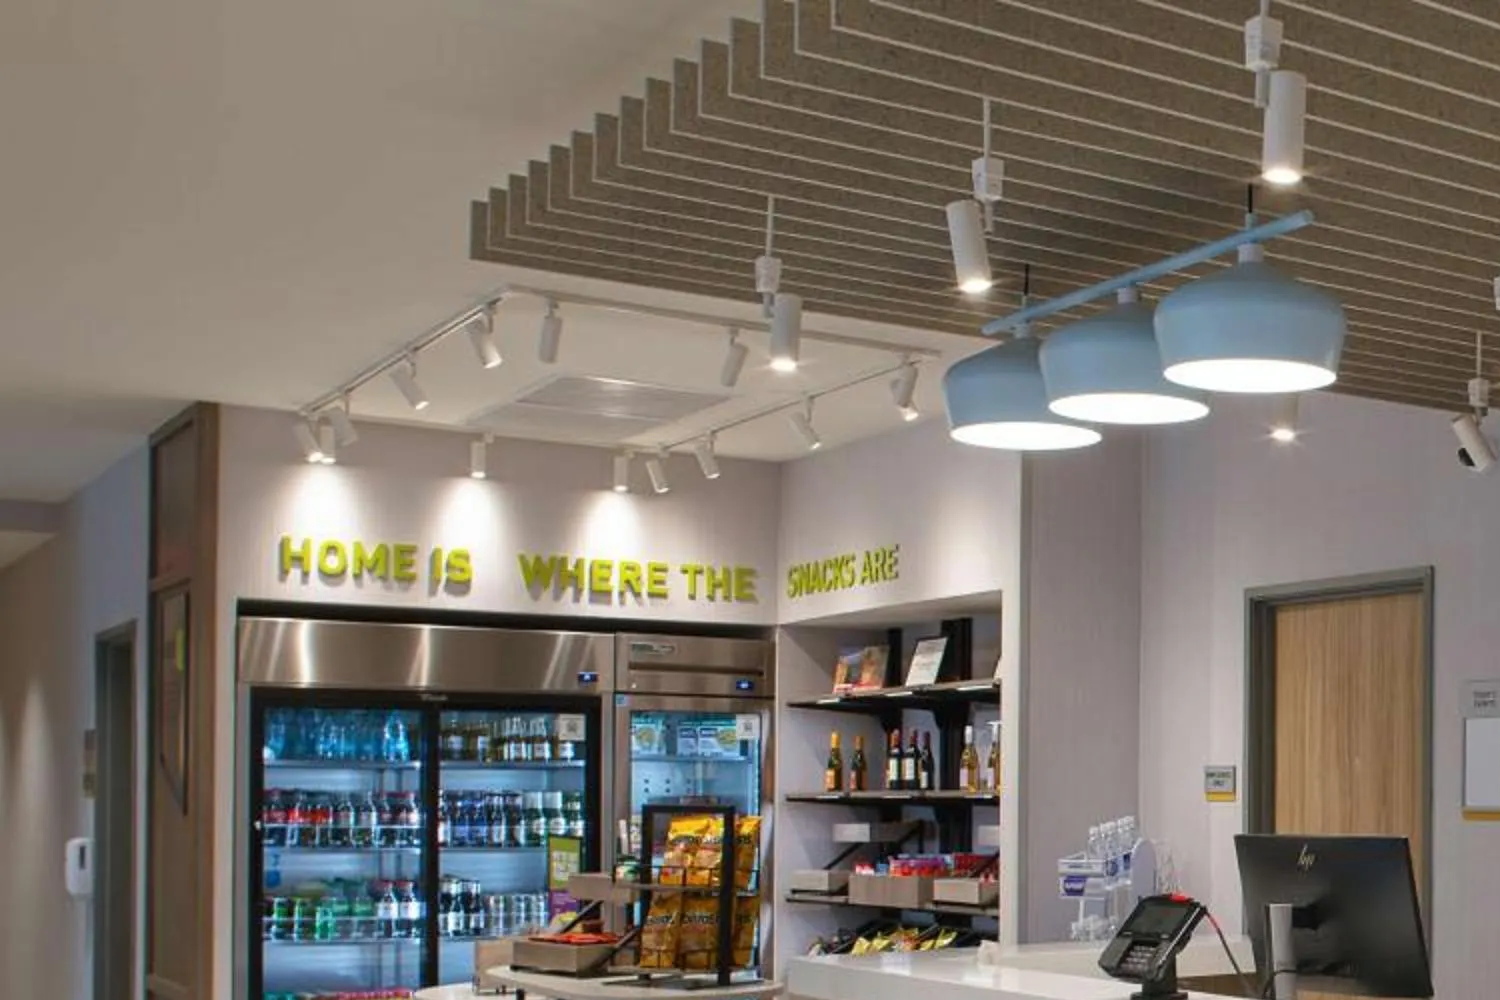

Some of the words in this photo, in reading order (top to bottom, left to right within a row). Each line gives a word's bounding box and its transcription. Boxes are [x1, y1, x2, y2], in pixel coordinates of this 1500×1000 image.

[280, 533, 418, 581] HOME
[431, 546, 473, 584] IS
[517, 554, 669, 598] WHERE
[680, 564, 758, 602] THE
[786, 552, 856, 598] SNACKS
[860, 544, 899, 585] ARE
